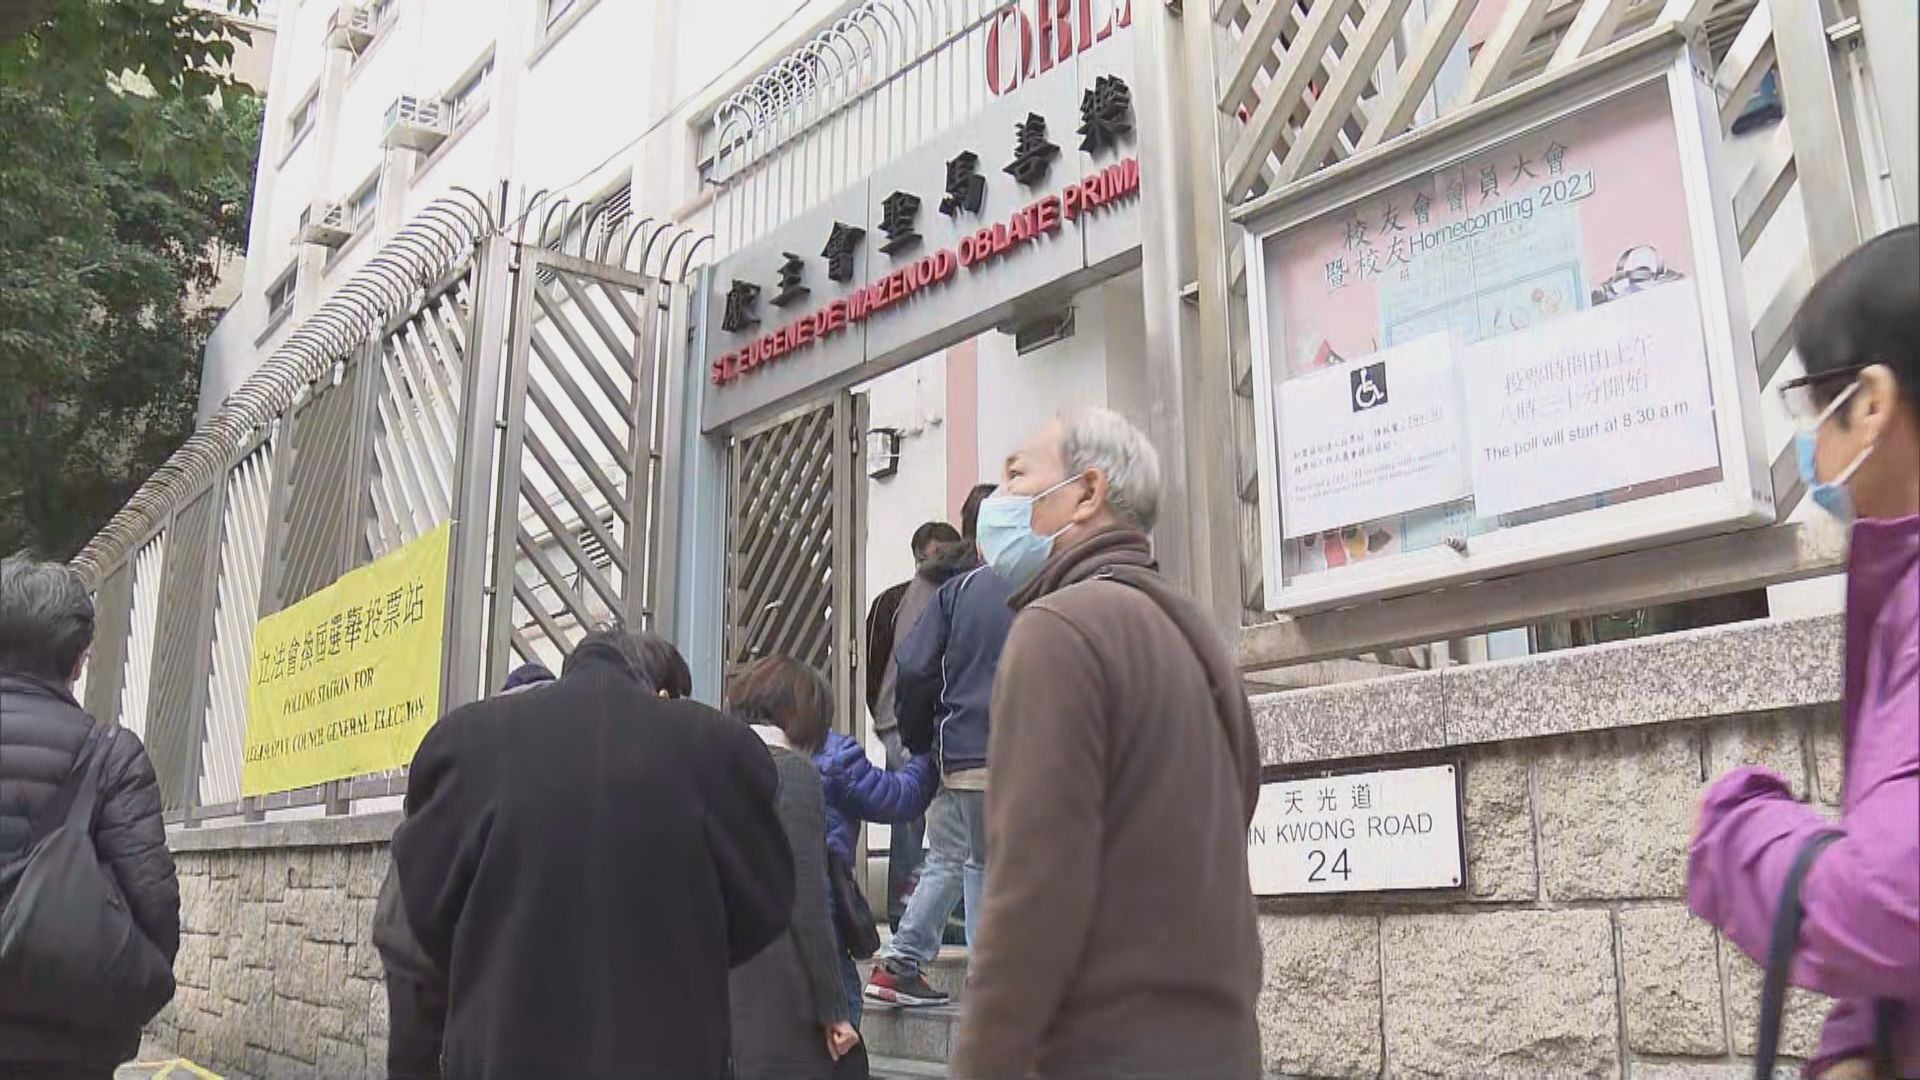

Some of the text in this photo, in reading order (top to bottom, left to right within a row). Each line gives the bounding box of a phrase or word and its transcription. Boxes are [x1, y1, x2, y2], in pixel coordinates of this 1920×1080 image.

[986, 0, 1131, 96] OBL
[1410, 196, 1535, 255] Homecoming
[1539, 169, 1595, 207] 2021
[738, 315, 815, 373] EUGENE
[814, 301, 847, 336] DE
[846, 248, 956, 322] MAZENOD
[957, 193, 1060, 267] OBLATE
[1484, 446, 1511, 461] The
[1514, 436, 1538, 458] poll
[1542, 429, 1564, 447] will
[1569, 421, 1599, 441] start
[1604, 416, 1618, 432] at
[283, 667, 374, 717] POLLING STATION FOR
[292, 727, 325, 754] COUNCIL
[326, 713, 370, 741] GENERAL
[374, 696, 426, 732] ELECTION
[1285, 784, 1371, 815] 天光道
[1276, 818, 1355, 843] KWONG
[1368, 813, 1432, 837] ROAD
[1308, 848, 1351, 882] 24
